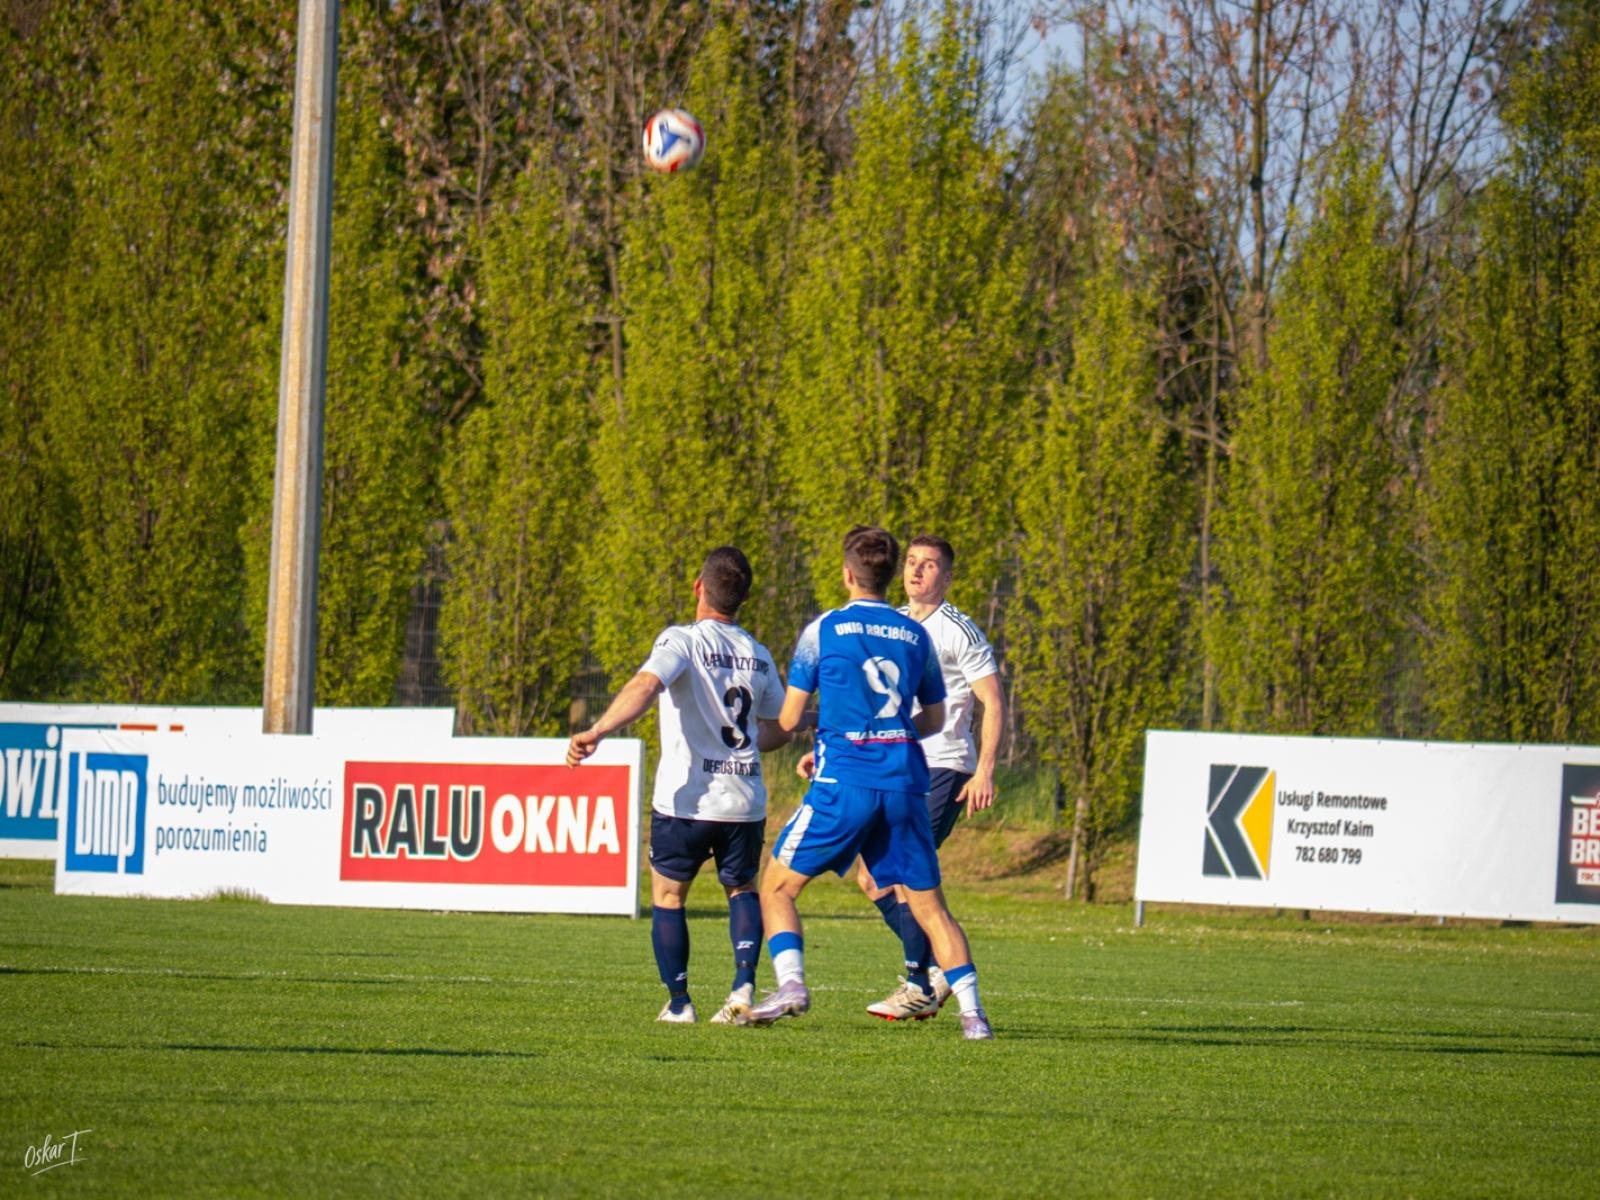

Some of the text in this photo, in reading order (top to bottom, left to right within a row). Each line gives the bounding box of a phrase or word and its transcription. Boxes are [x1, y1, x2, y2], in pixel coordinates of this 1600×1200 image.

[834, 622, 864, 636] UNIA
[862, 656, 901, 719] 9
[721, 686, 753, 750] 3
[157, 774, 333, 813] budujemy możliwości
[1278, 791, 1388, 811] Usługi Remontowe
[74, 752, 138, 874] bmp
[350, 783, 620, 861] RALU OKNA
[1287, 819, 1374, 838] Krzysztof Kaim
[155, 822, 267, 855] porozumienia
[1295, 846, 1362, 864] 782 680 799
